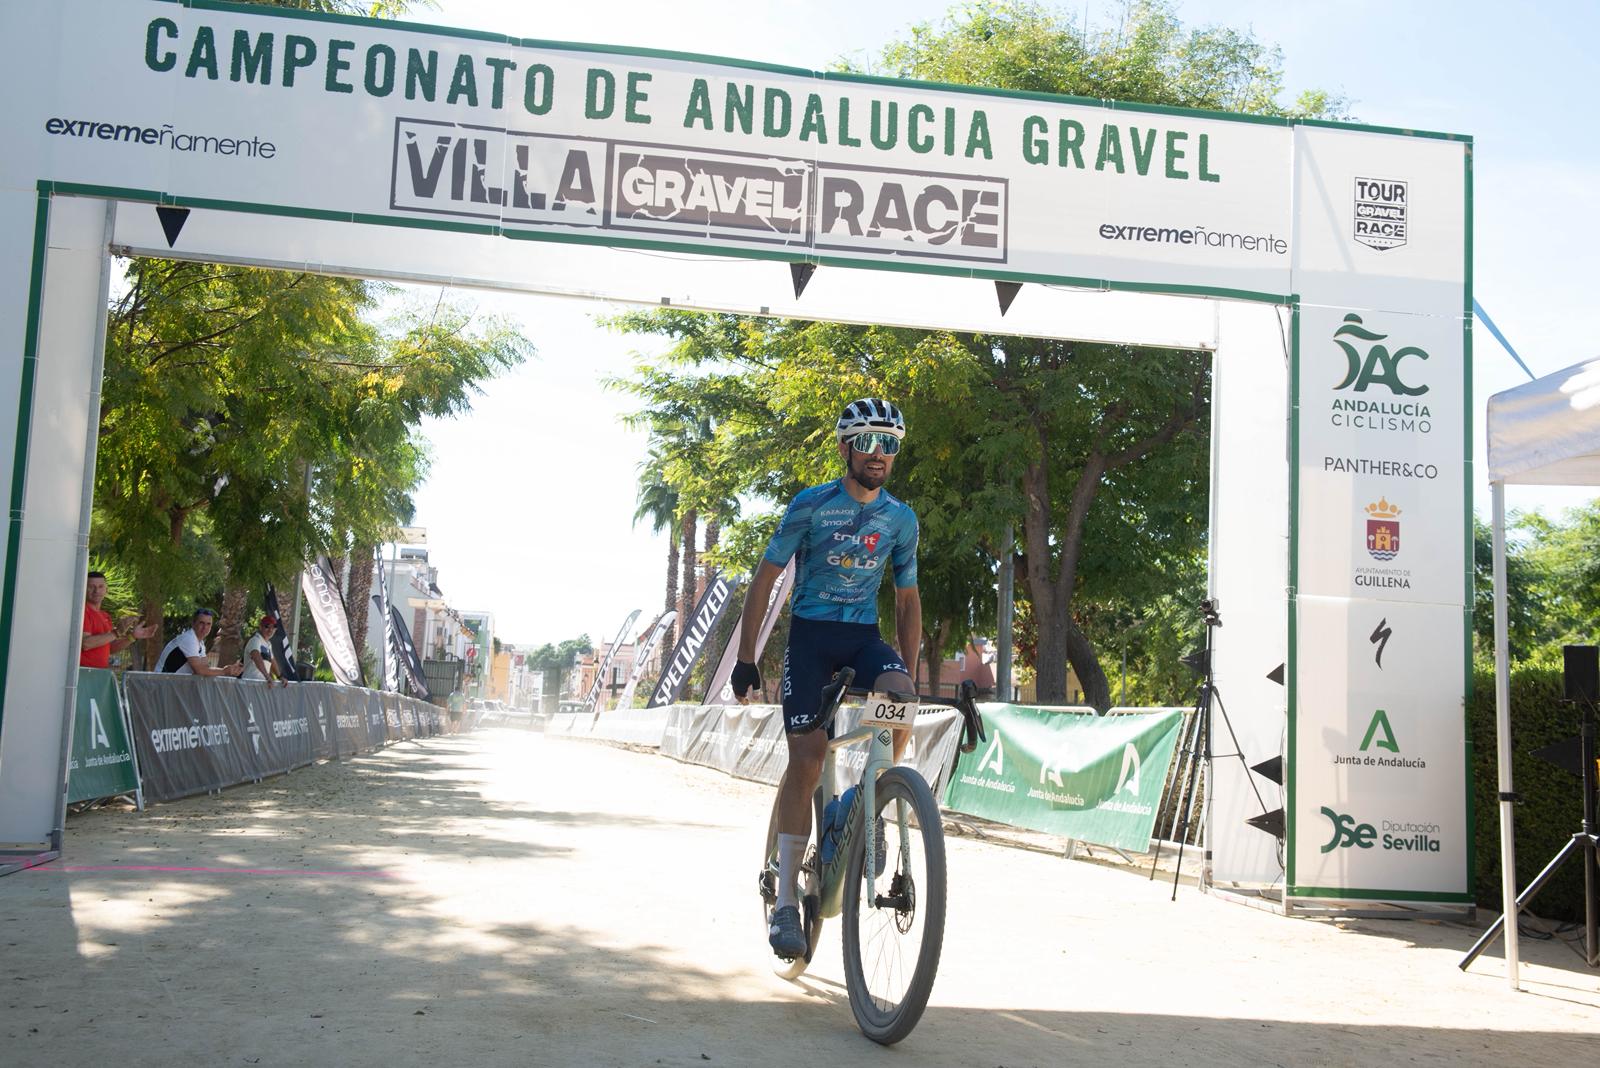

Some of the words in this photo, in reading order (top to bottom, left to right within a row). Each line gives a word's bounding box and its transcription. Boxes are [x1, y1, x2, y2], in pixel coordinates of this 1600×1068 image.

[145, 17, 554, 115] CAMPEONATO
[585, 68, 653, 124] DE
[684, 79, 994, 160] ANDALUCIA
[1022, 115, 1221, 183] GRAVEL
[45, 117, 277, 160] extremeñamente
[404, 131, 597, 215] VILLA
[621, 166, 803, 219] GRAVEL
[821, 177, 999, 249] RACE
[1357, 181, 1405, 203] TOUR
[1357, 205, 1404, 220] GRAVEL
[1357, 221, 1405, 237] RACE
[1100, 223, 1288, 255] extremeñamente
[1332, 399, 1431, 417] ANDALUCÍA
[1331, 414, 1431, 433] CICLISMO
[1324, 457, 1438, 479] PANTHER&CO
[833, 531, 860, 545] try
[864, 535, 876, 545] it
[1356, 568, 1402, 576] AYUNTAMIENTO
[1355, 575, 1411, 589] GUILLENA
[654, 579, 729, 706] SPECIALIZED
[875, 703, 906, 721] 034
[1334, 755, 1361, 765] Junta
[1363, 756, 1376, 766] de
[1378, 757, 1426, 768] Andalucía
[1382, 820, 1440, 834] Diputación
[1382, 834, 1441, 852] Sevilla
